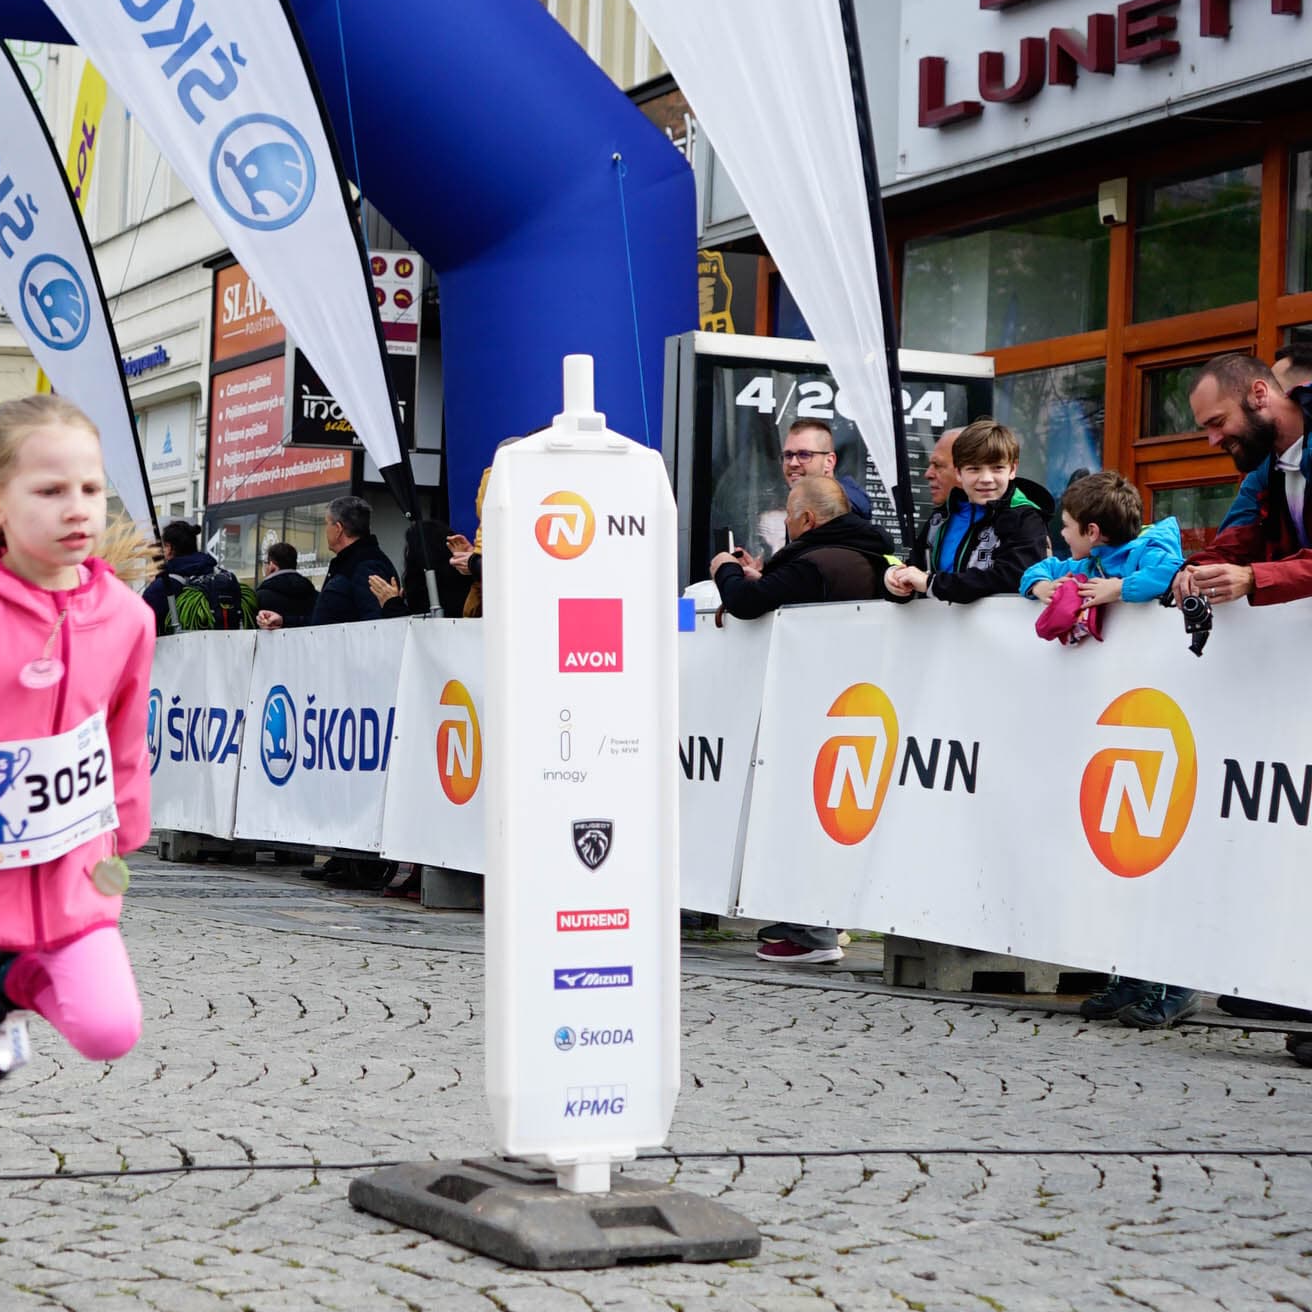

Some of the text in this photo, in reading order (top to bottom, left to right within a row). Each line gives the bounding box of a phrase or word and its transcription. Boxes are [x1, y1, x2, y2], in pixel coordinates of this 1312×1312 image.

[607, 514, 646, 536] NN
[565, 652, 617, 667] AVON
[898, 736, 980, 794] NN
[25, 748, 107, 813] 3052
[543, 769, 588, 784] innogy
[1220, 759, 1312, 826] NN
[561, 913, 627, 929] NUTREND
[579, 1028, 634, 1046] ŠKODA
[564, 1097, 625, 1117] KPMG
